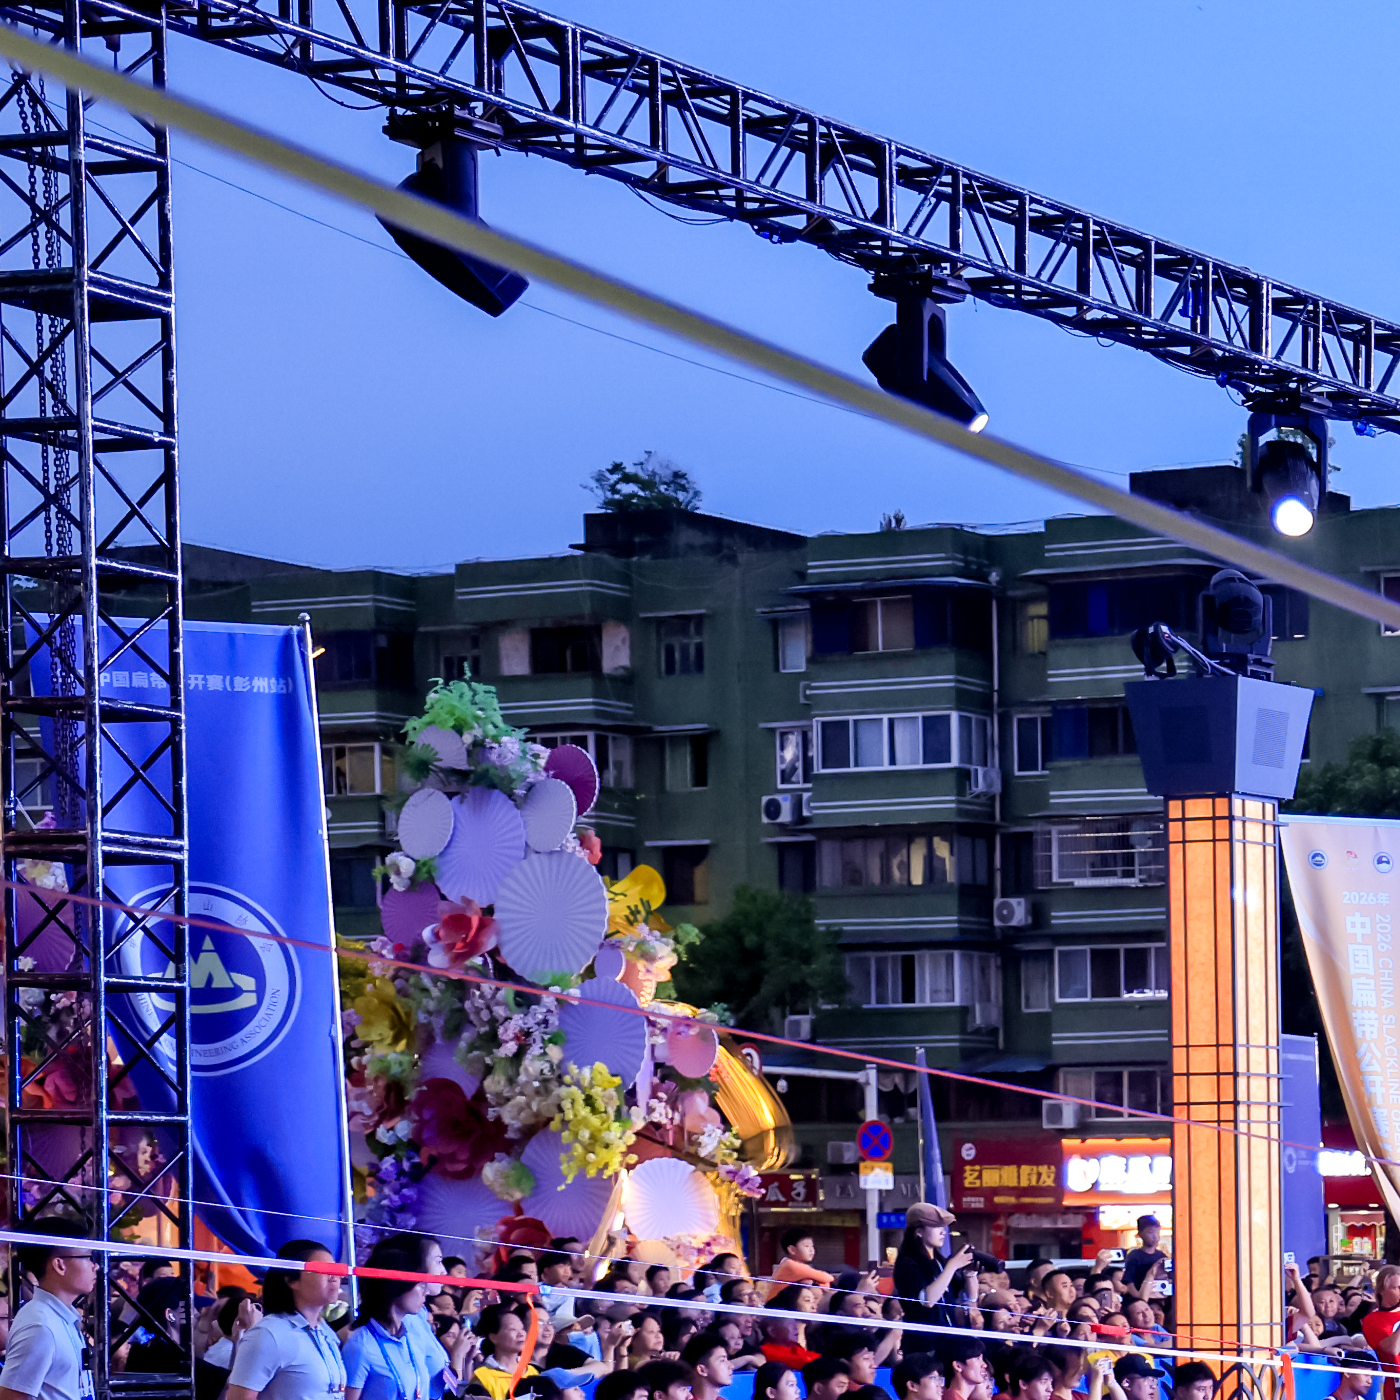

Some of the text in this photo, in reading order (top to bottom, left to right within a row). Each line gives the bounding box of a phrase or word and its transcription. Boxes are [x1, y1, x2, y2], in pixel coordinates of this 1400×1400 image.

[99, 670, 293, 694] 中国扁带开赛(彭州站)
[1342, 891, 1390, 906] 2026年
[1375, 913, 1393, 953] 2026
[1378, 957, 1396, 1010] CHINA
